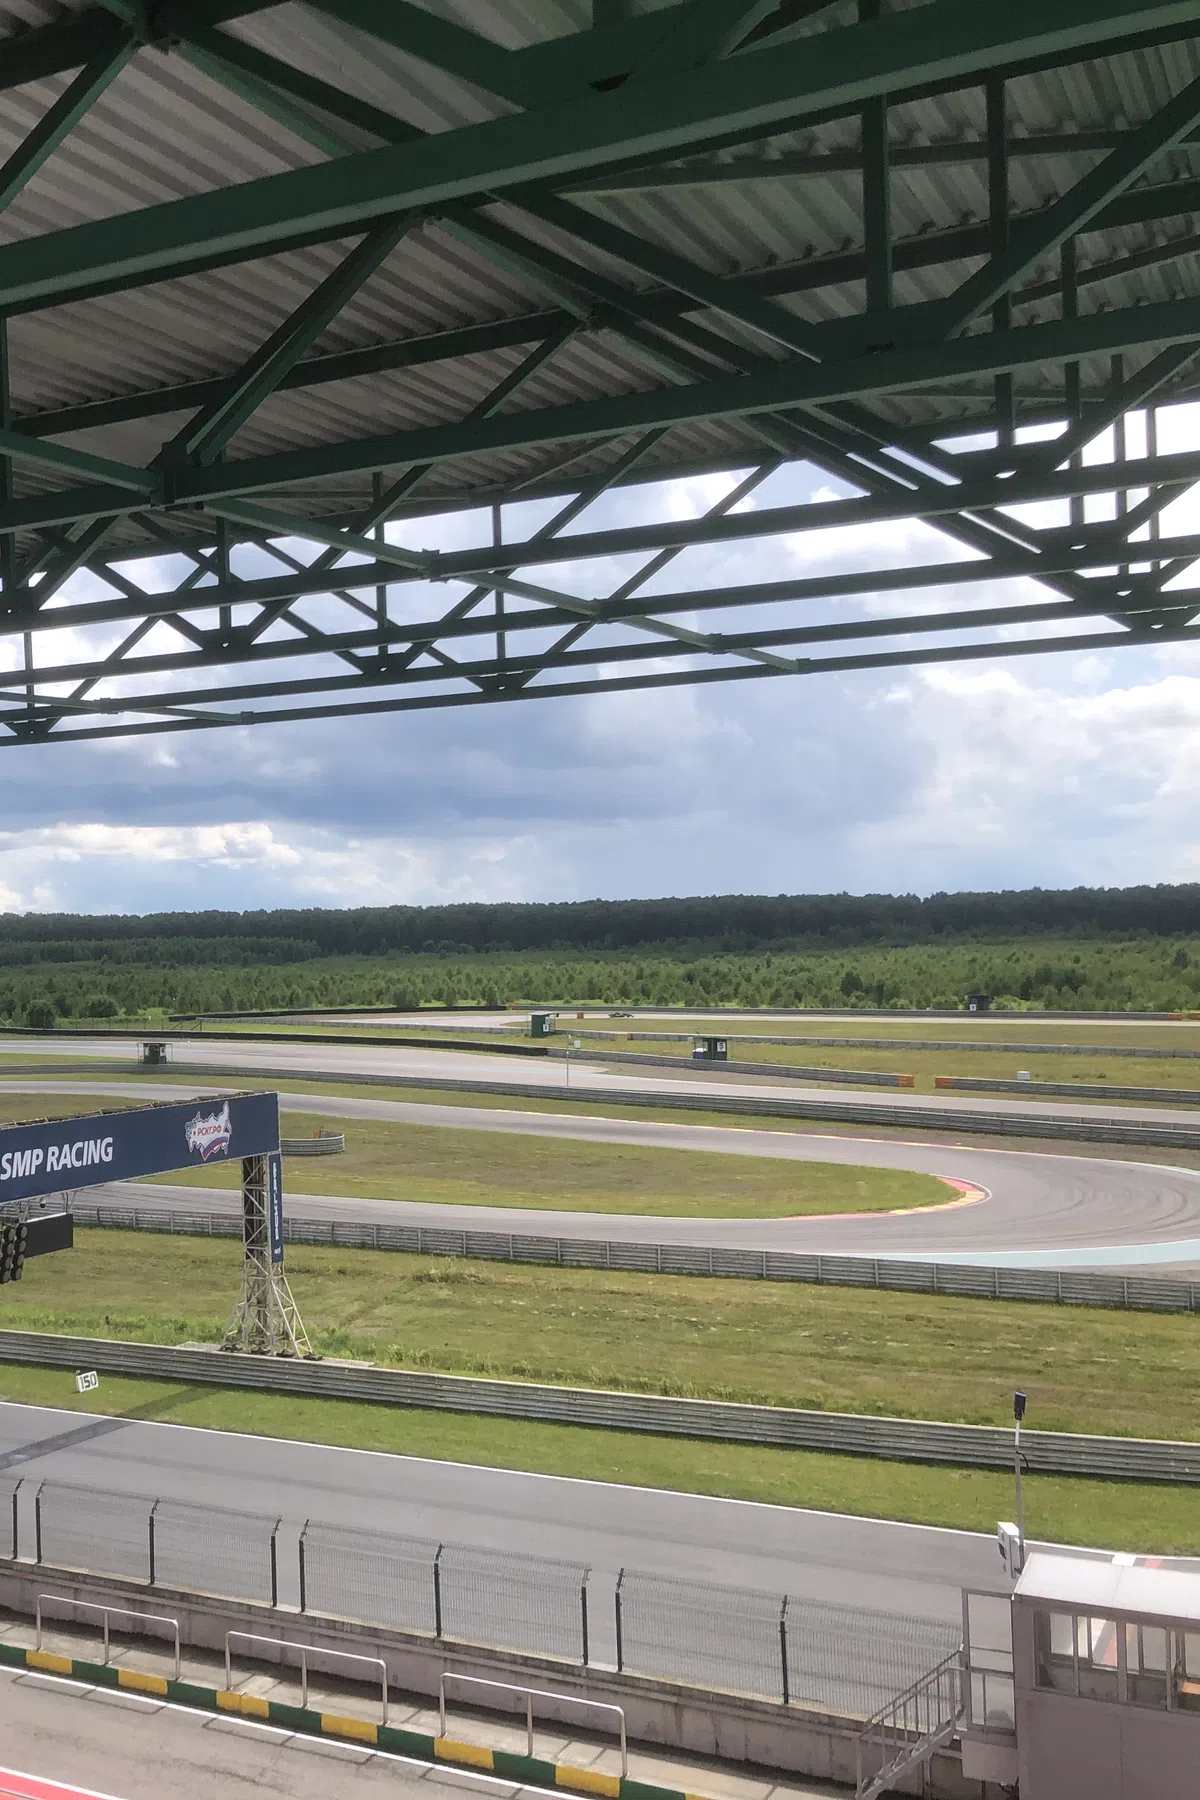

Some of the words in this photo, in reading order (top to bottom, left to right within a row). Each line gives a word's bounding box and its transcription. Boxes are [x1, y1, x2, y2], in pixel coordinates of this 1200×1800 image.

[197, 1124, 222, 1136] РСКГ.РФ
[0, 1148, 44, 1181] SMP
[46, 1136, 114, 1172] RACING
[79, 1372, 97, 1390] 150
